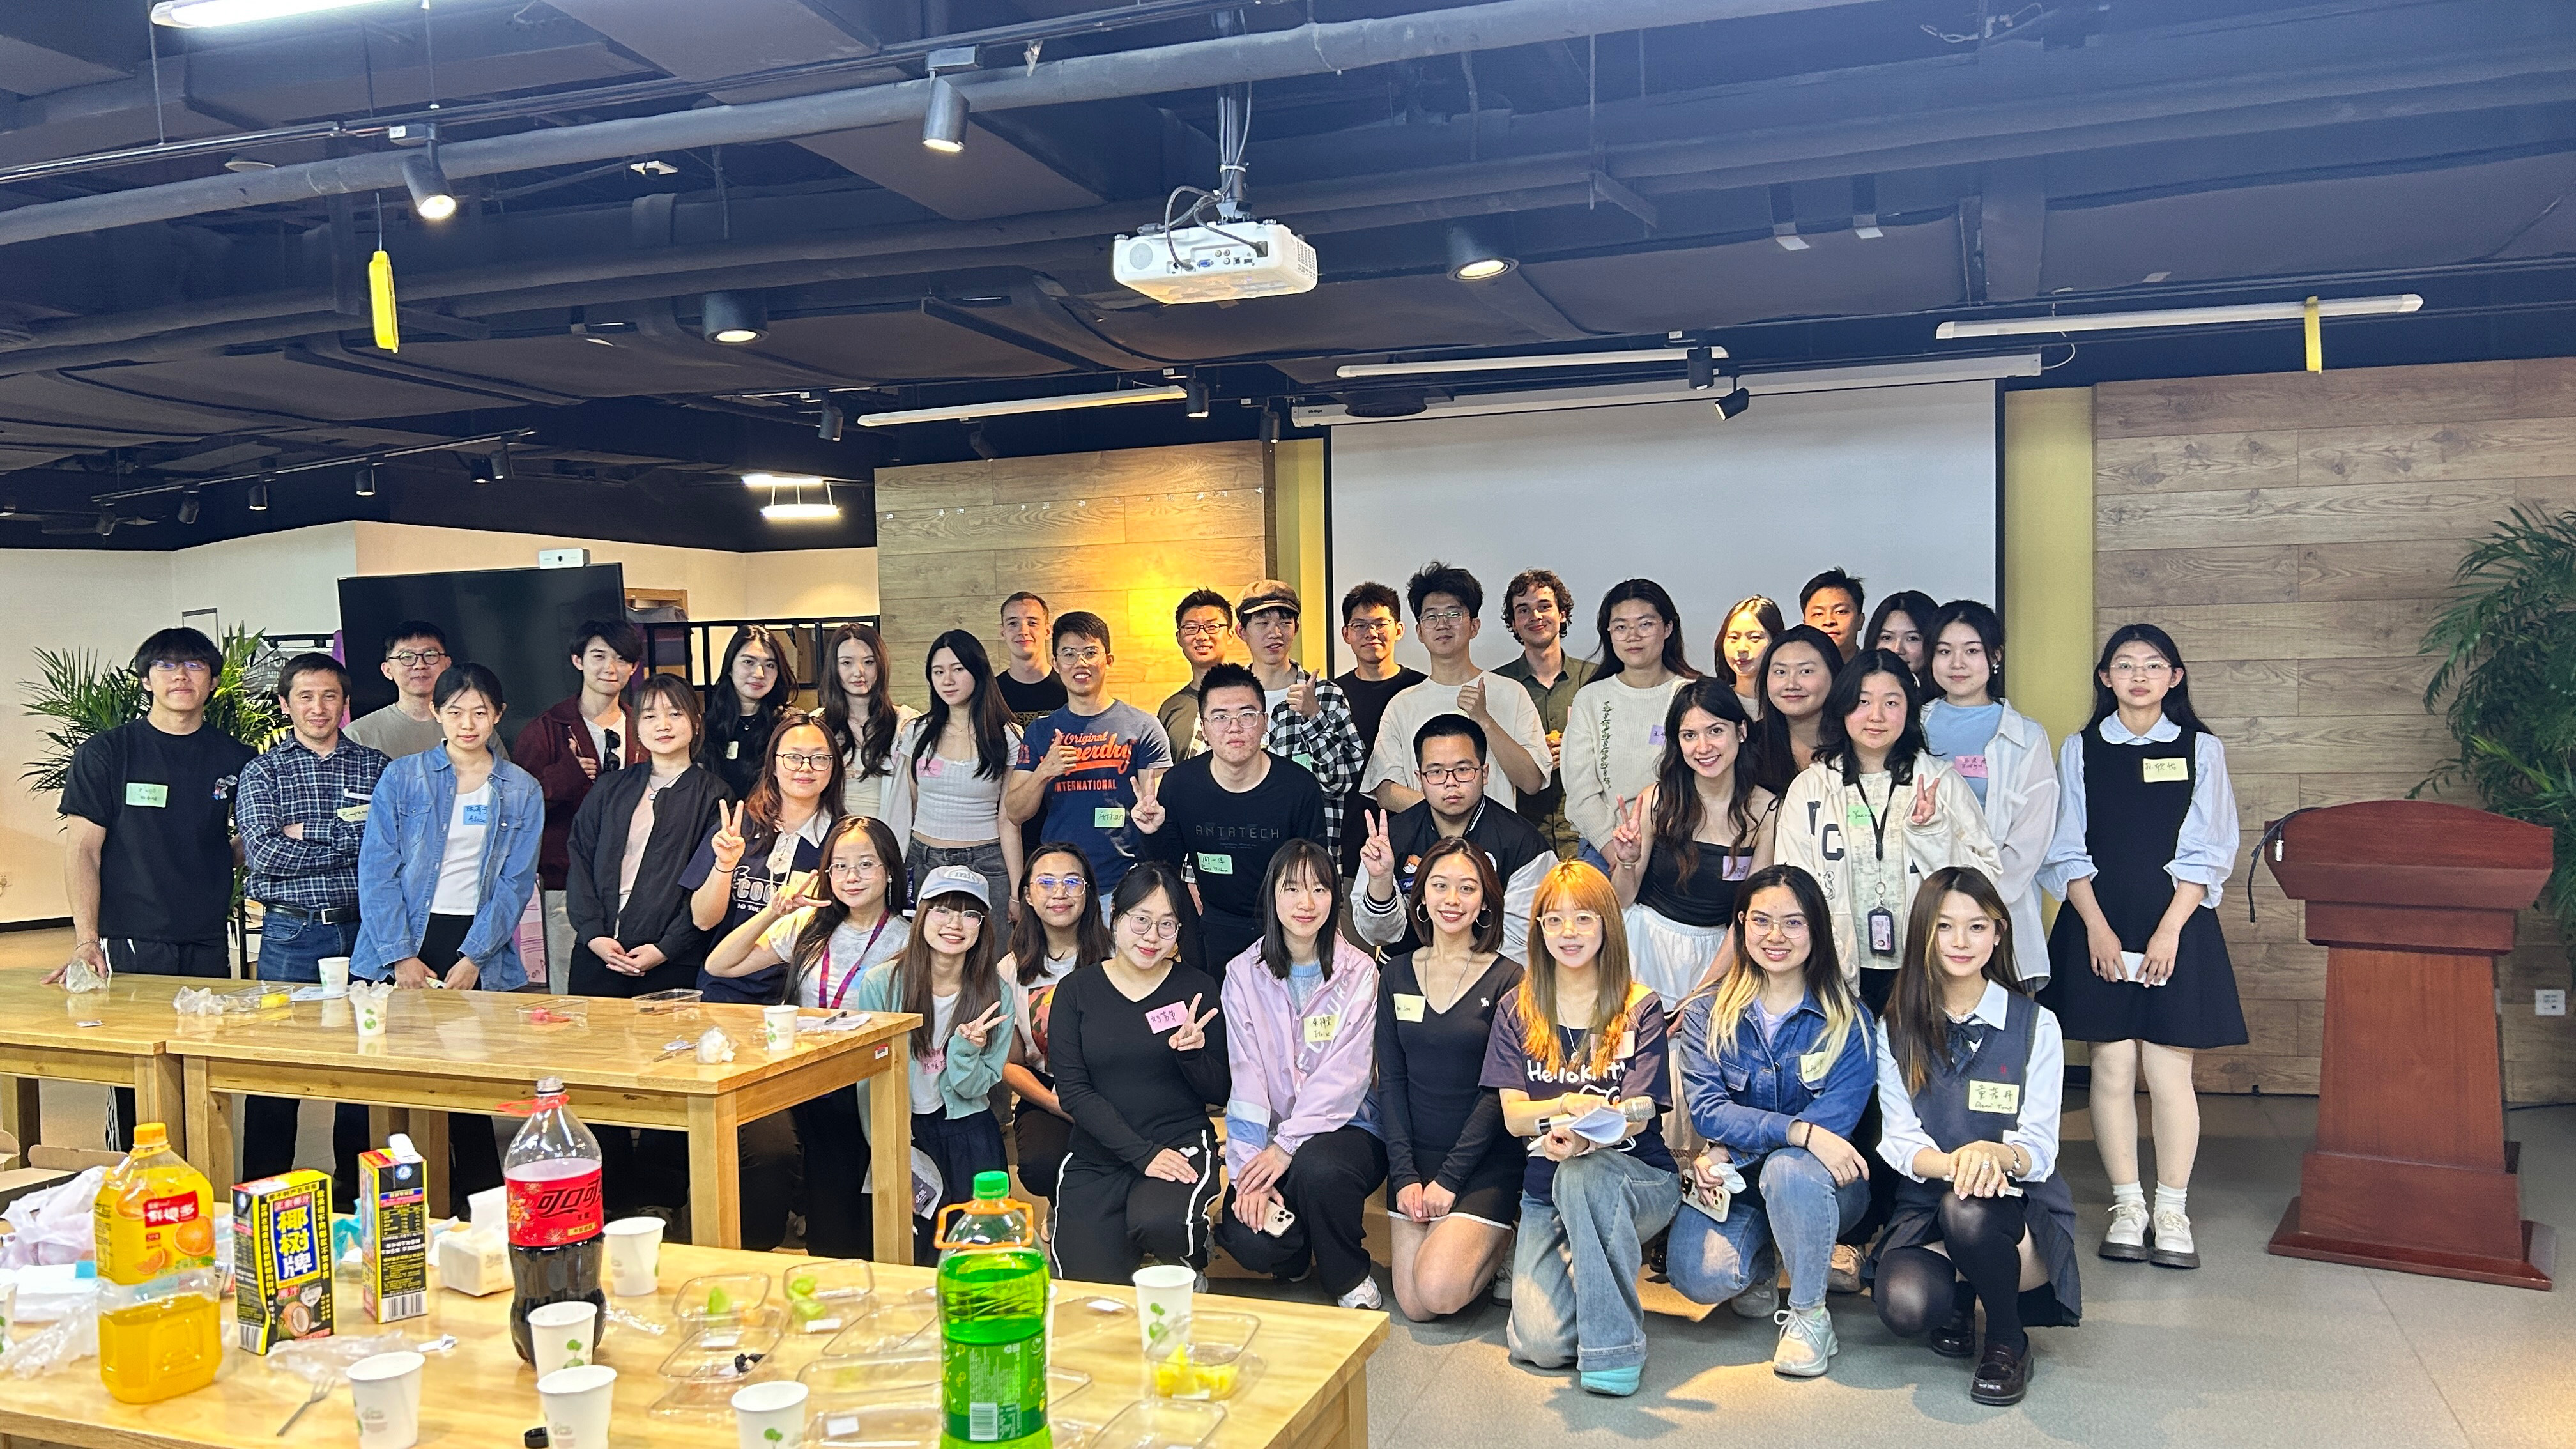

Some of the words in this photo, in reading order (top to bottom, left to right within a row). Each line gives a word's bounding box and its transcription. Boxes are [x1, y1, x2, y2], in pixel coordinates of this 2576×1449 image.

[1063, 730, 1108, 746] Original
[1055, 779, 1117, 792] INTERNATIONAL
[276, 1205, 313, 1278] 椰树牌
